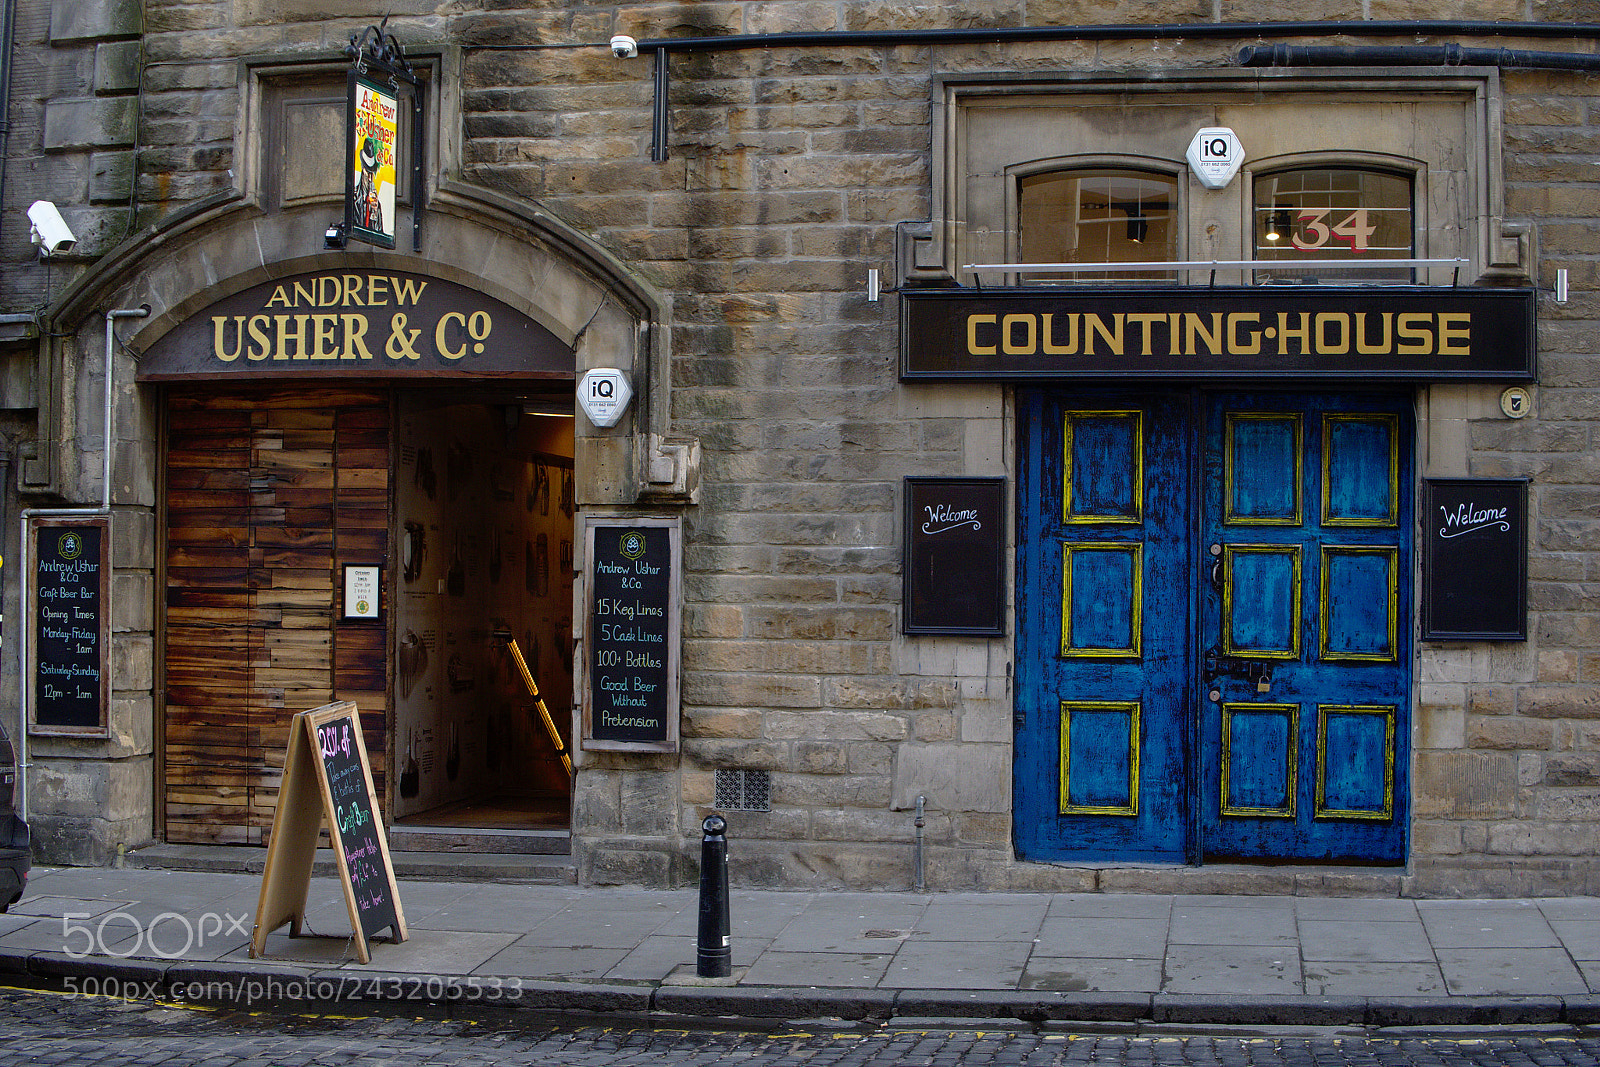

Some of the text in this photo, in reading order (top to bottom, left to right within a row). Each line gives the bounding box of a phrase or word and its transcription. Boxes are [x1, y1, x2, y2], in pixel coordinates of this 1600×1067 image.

[361, 90, 395, 120] Andrew
[366, 112, 395, 146] Usher
[1204, 138, 1227, 157] iQ
[1291, 209, 1377, 253] 34
[264, 274, 428, 308] ANDREW
[211, 313, 373, 362] USHER
[385, 312, 422, 360] &
[592, 379, 614, 398] iQ
[924, 504, 978, 523] Welcome
[1440, 502, 1507, 527] Welcome
[597, 560, 660, 575] Andrew Usher
[40, 586, 95, 602] Craft Beer Bar
[42, 606, 68, 623] Opening
[597, 598, 663, 621] 15 Keg Lines
[601, 623, 663, 643] 5 Cask Lines
[76, 642, 92, 653] 1am
[597, 650, 662, 668] 100+ Bottles
[44, 684, 63, 700] 12pm
[76, 684, 92, 698] 1am
[600, 675, 657, 692] Good Beer
[612, 693, 647, 707] Without
[602, 709, 659, 727] Pretension
